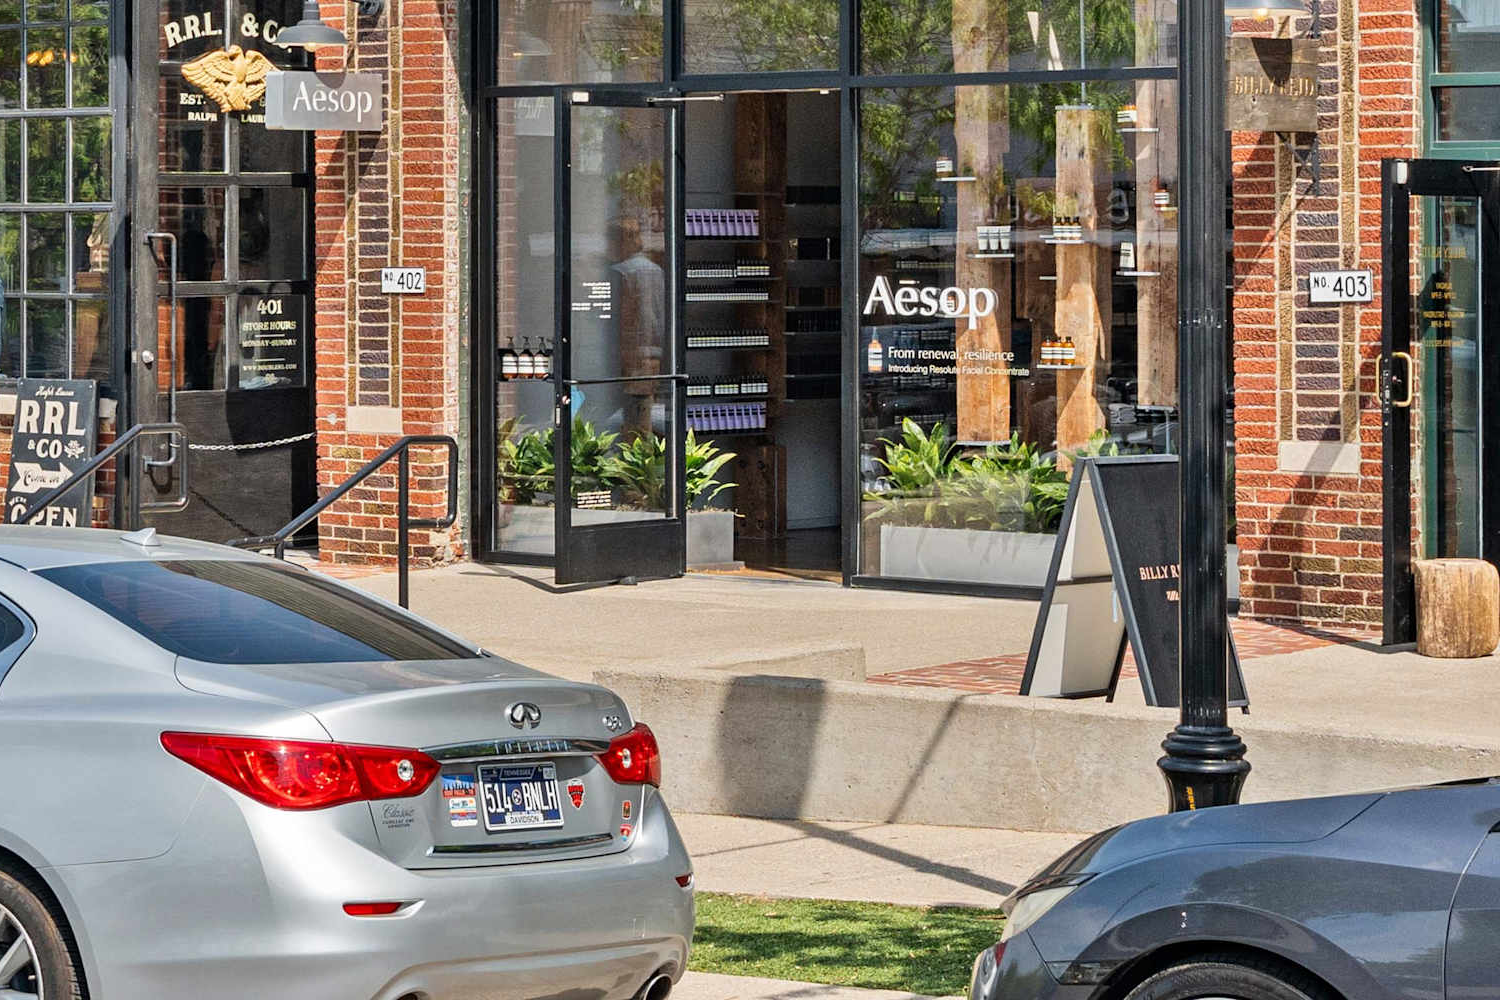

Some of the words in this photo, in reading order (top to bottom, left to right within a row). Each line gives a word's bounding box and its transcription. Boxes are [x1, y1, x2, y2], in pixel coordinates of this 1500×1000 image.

[164, 12, 222, 48] R.R.L.
[241, 13, 259, 37] &
[180, 92, 206, 105] EST.
[188, 112, 217, 122] RALPH
[397, 271, 422, 290] 402
[1333, 275, 1367, 297] 403
[257, 299, 283, 315] 401
[242, 321, 269, 331] STORE
[269, 320, 297, 330] HOURS
[888, 347, 916, 359] From
[918, 349, 962, 361] renewal,
[964, 350, 1015, 362] resilience
[888, 365, 928, 375] Introducing
[18, 399, 86, 436] RRL
[27, 439, 36, 450] &
[36, 438, 63, 459] CO
[1139, 565, 1168, 580] BILLY
[1170, 564, 1180, 578] R
[484, 782, 513, 813] 514
[521, 780, 558, 811] BNLH
